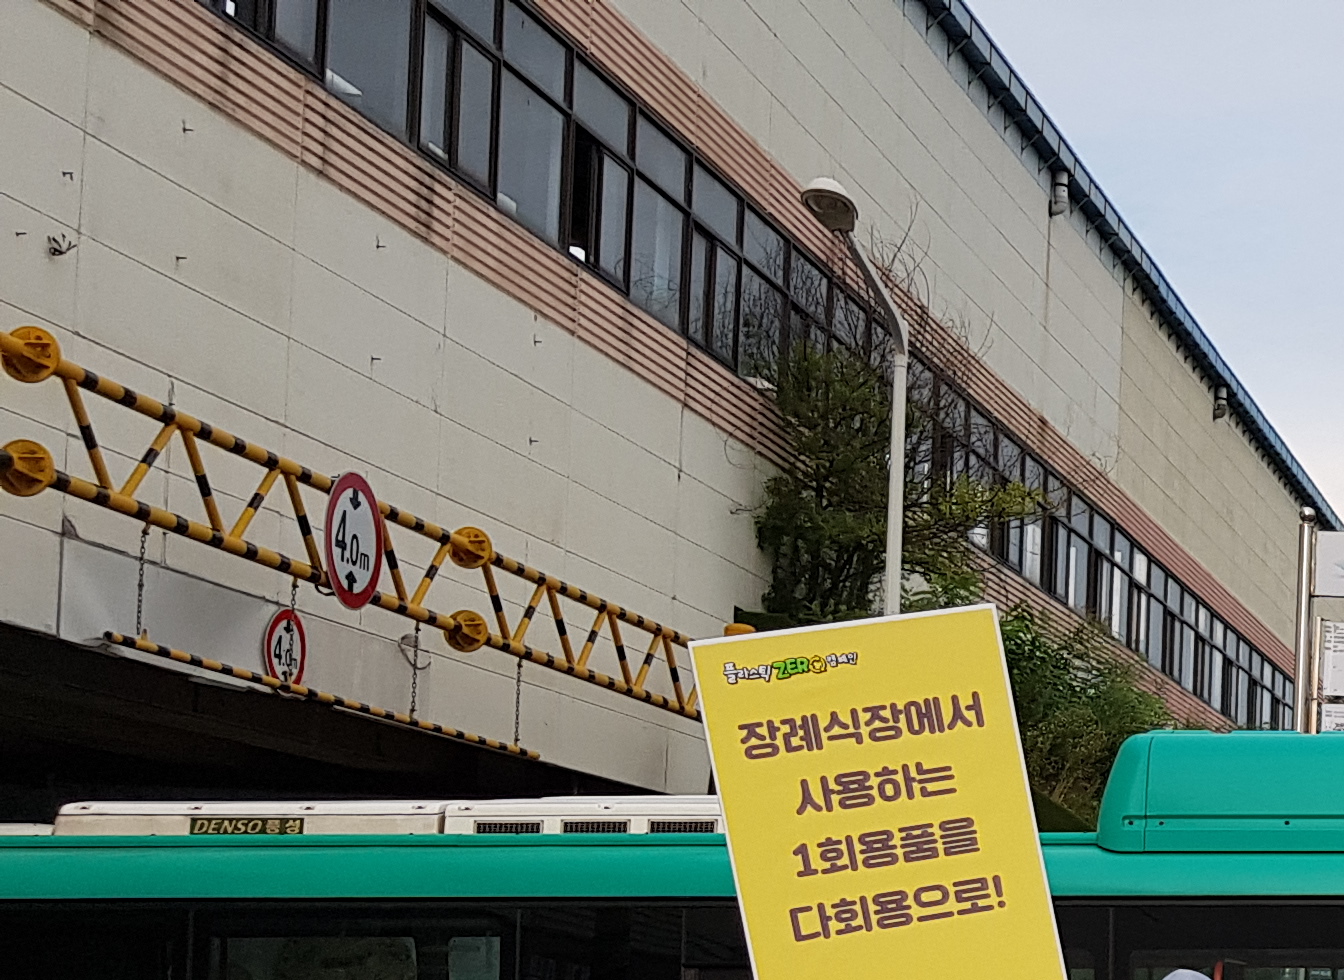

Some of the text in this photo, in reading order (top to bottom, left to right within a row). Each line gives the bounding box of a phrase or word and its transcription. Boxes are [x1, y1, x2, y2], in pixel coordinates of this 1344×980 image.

[335, 510, 369, 571] 4.0m
[723, 655, 828, 684] 플라스틱 ZERO
[738, 690, 986, 760] 장례식장에서
[795, 761, 958, 817] 사용하는
[193, 819, 263, 834] DENSO
[792, 816, 981, 878] 1회용품을
[789, 874, 1008, 943] 다회용으로!
